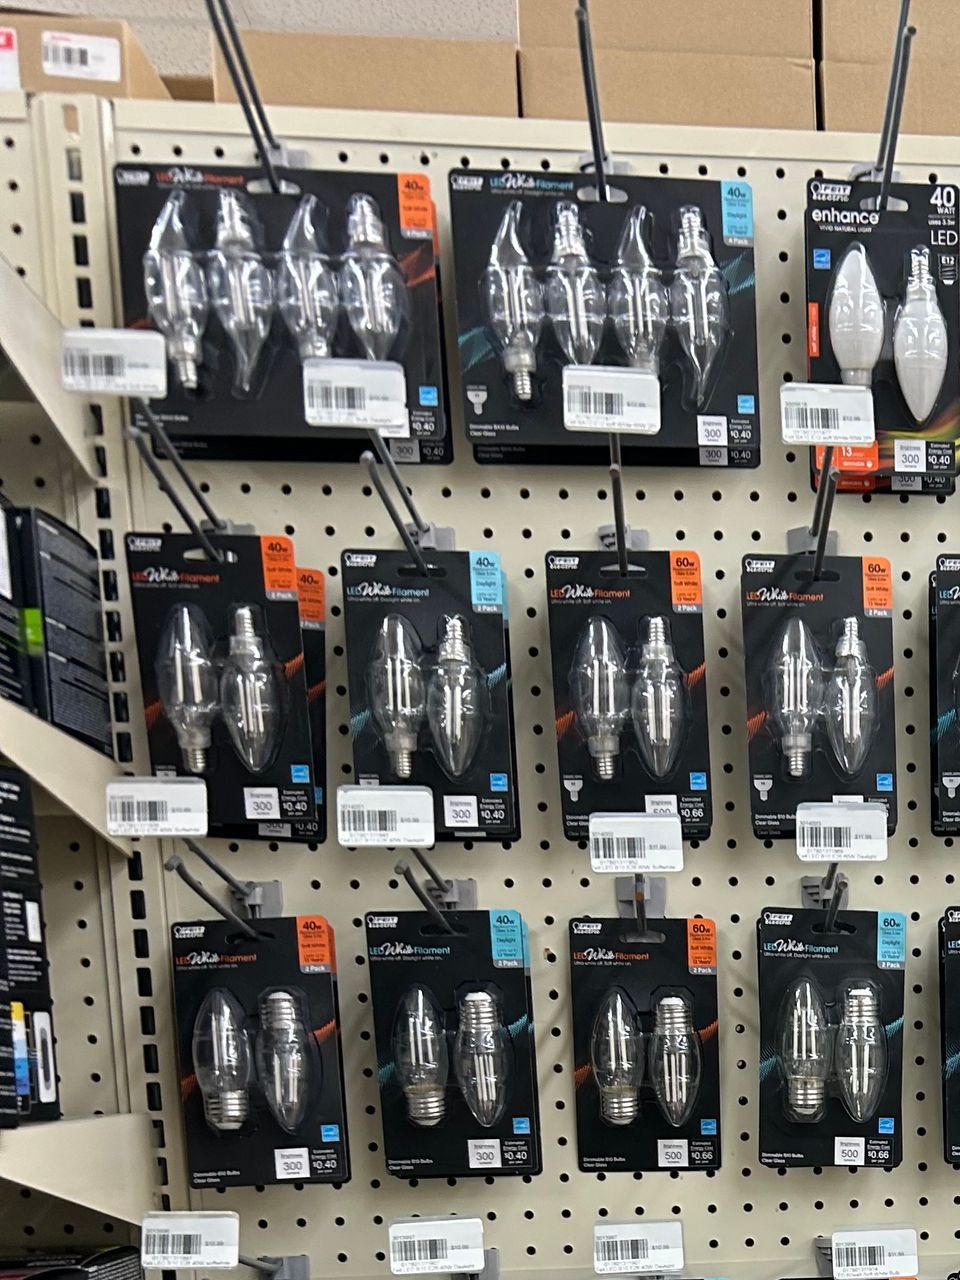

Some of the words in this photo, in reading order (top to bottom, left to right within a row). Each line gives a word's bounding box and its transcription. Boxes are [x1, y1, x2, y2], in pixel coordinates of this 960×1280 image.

[930, 187, 955, 206] 40
[812, 208, 879, 224] enhance
[931, 230, 958, 245] LED
[704, 429, 721, 438] 300
[730, 430, 751, 439] $0.40
[902, 453, 919, 463] 300
[928, 455, 950, 465] $0.40
[676, 557, 695, 568] 60w
[868, 564, 886, 573] 60w
[747, 593, 760, 601] LED
[757, 587, 789, 601] White
[789, 593, 824, 601] Filament
[883, 919, 901, 928] 60w
[693, 925, 711, 934] 60w
[764, 943, 777, 951] LED
[775, 939, 804, 951] White
[805, 945, 838, 953] Filament
[840, 1149, 858, 1158] 500
[867, 1150, 889, 1159] $0.66
